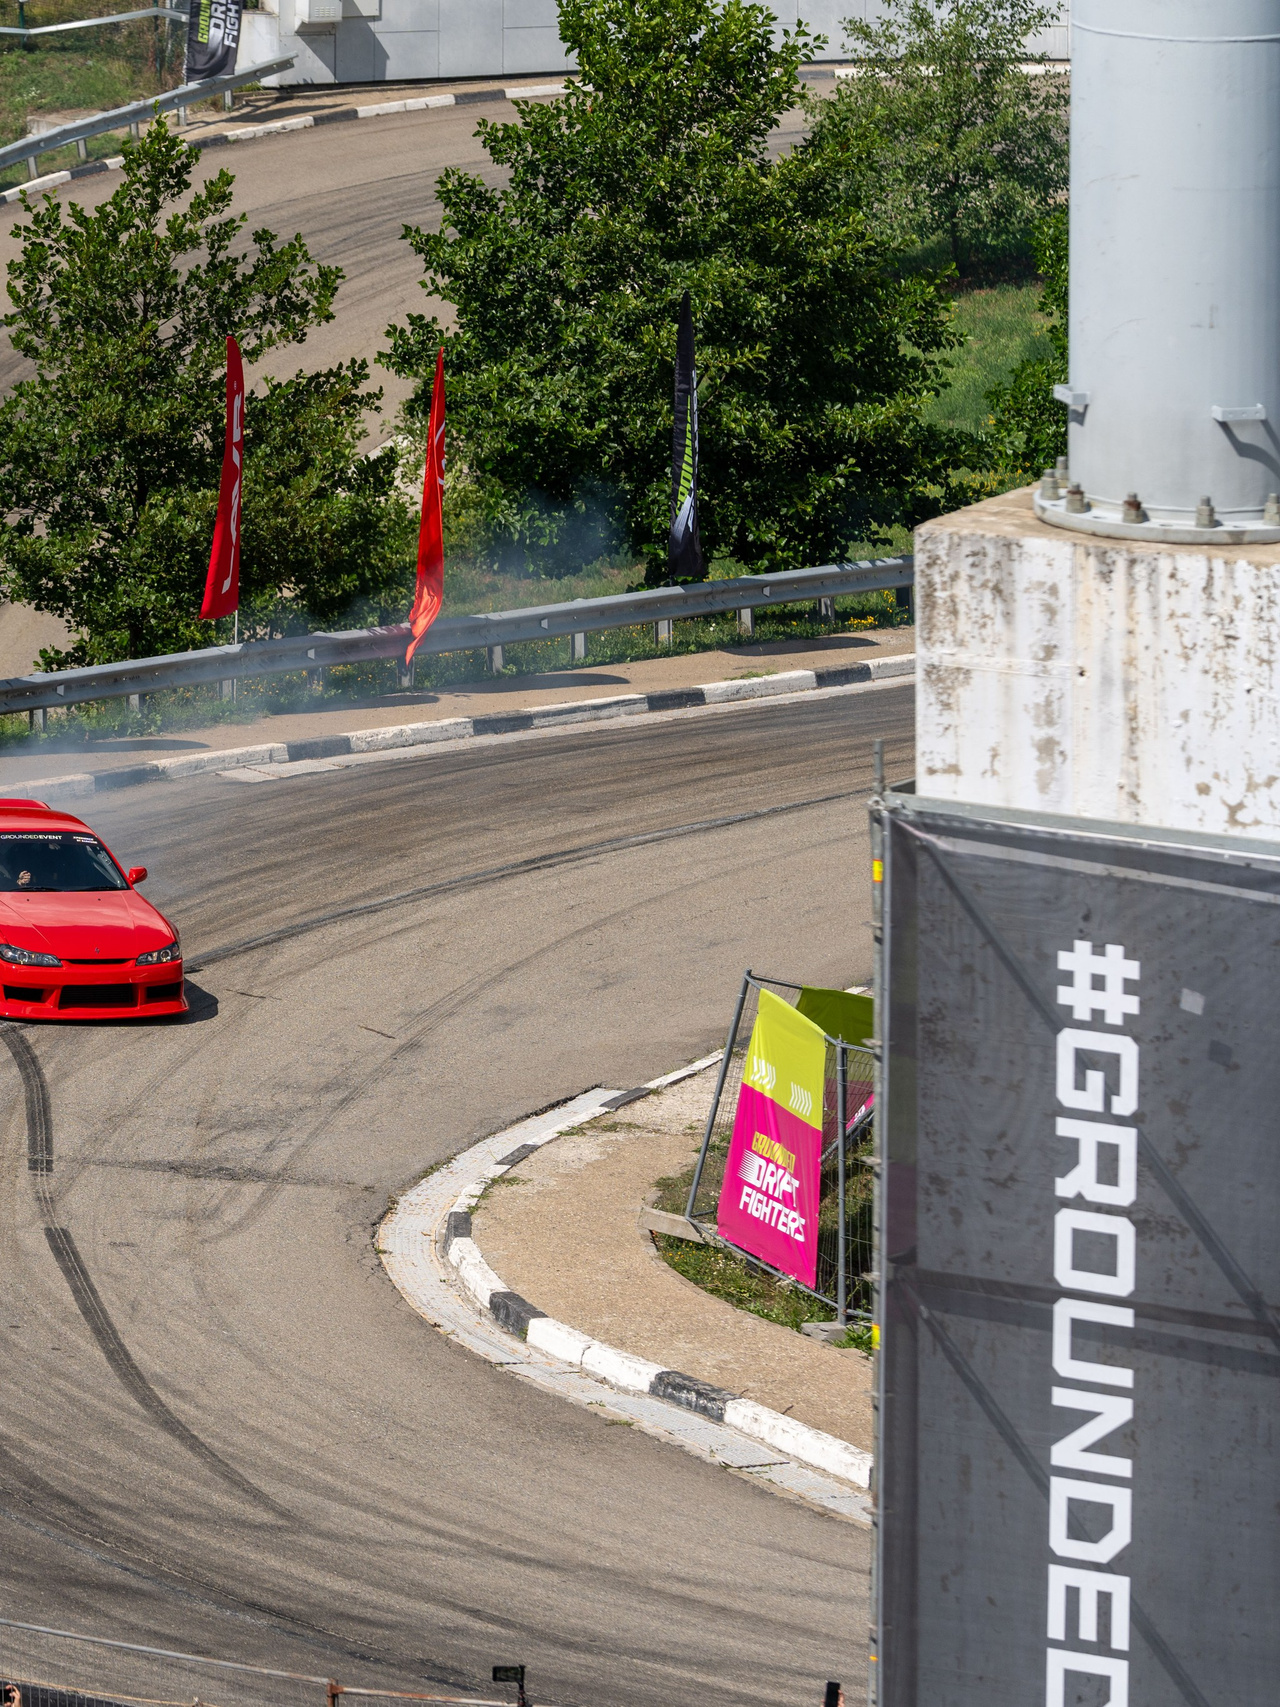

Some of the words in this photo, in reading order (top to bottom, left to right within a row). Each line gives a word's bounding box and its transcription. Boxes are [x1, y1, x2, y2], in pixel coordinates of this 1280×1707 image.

[223, 0, 239, 48] FIGH
[750, 1155, 800, 1208] DRIFT
[739, 1185, 806, 1243] FIGHTERS
[1045, 939, 1141, 1707] #GROUNDED
